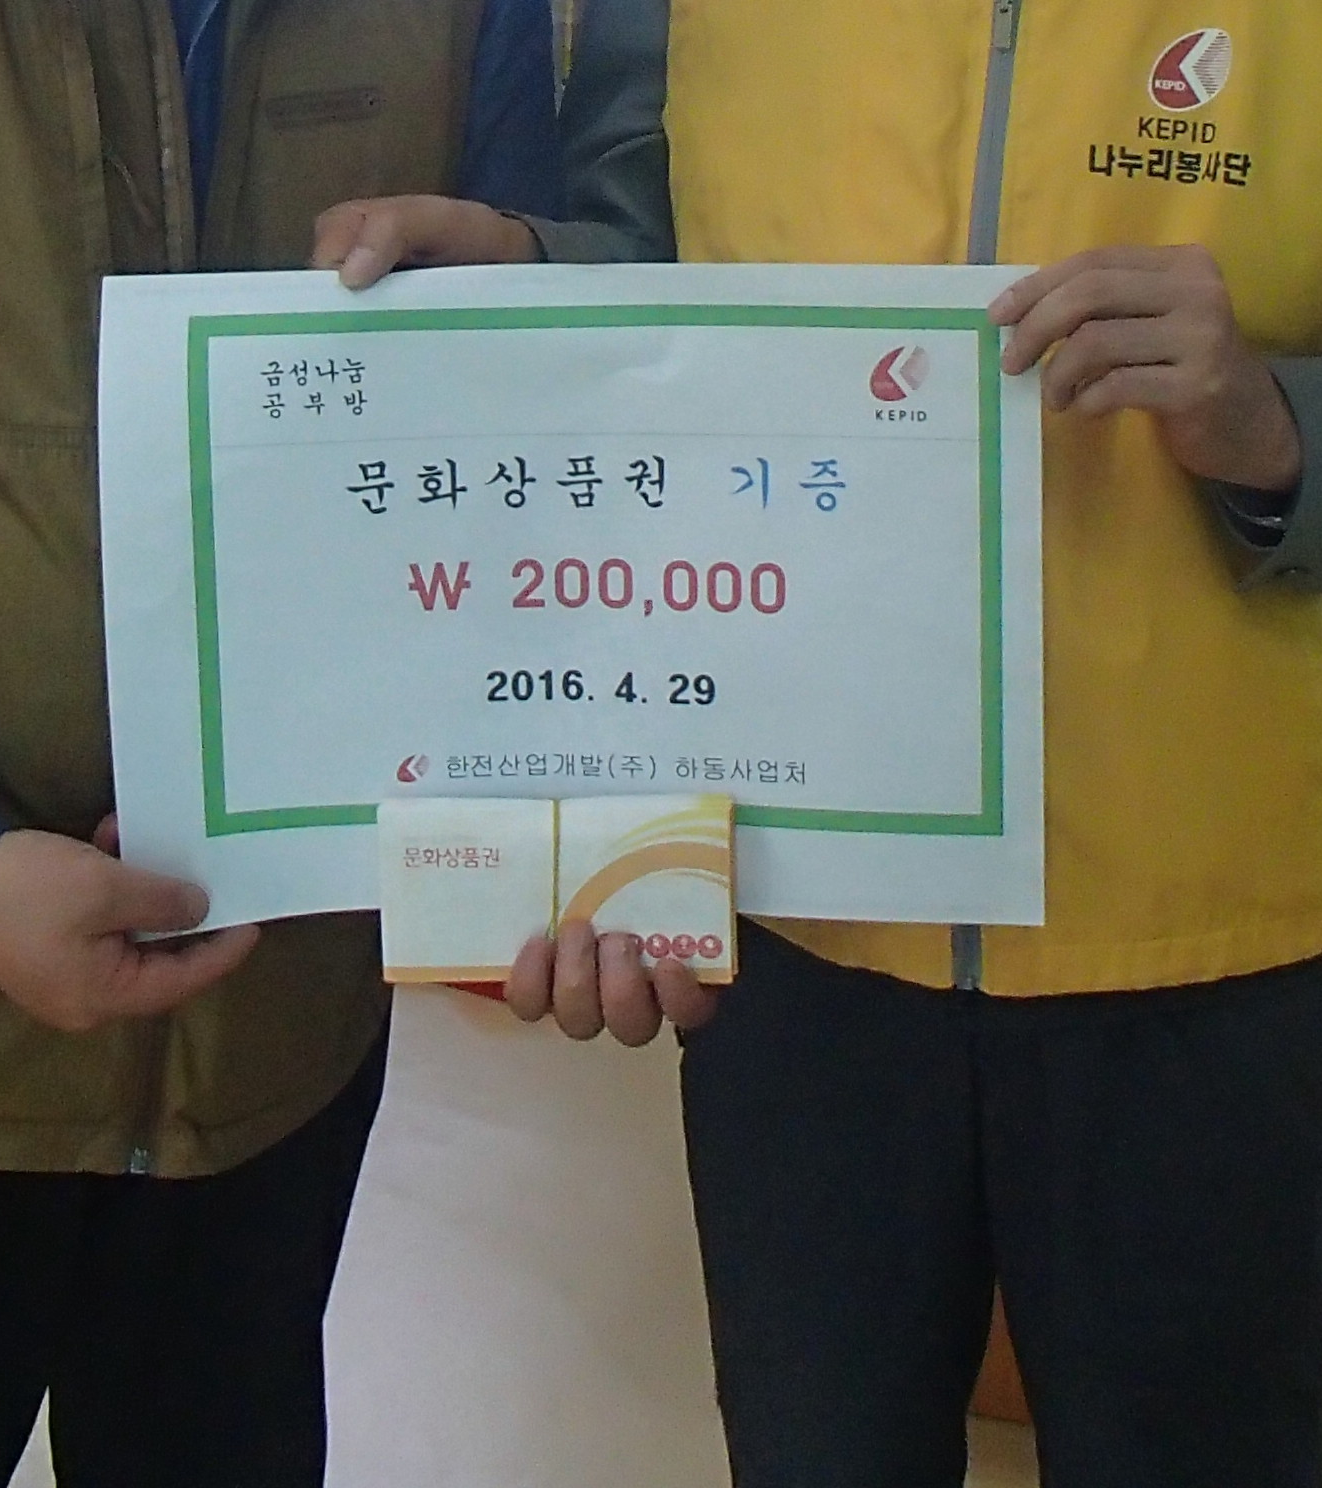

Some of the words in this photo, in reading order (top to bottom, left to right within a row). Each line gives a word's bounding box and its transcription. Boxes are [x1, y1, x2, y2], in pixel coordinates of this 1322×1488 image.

[1154, 79, 1186, 92] KEPID
[1138, 117, 1216, 143] KEPID
[1089, 145, 1251, 186] 나누리봉사단
[260, 358, 366, 387] 금성나눔
[875, 409, 927, 422] KEPID
[511, 557, 787, 617] 200,000
[486, 669, 594, 703] 2016.
[614, 672, 648, 705] 4.
[668, 673, 716, 706] 29
[446, 752, 657, 779] 한전산업개발(주)
[675, 756, 808, 787] 하동사업처
[403, 846, 500, 869] 문화상품권
